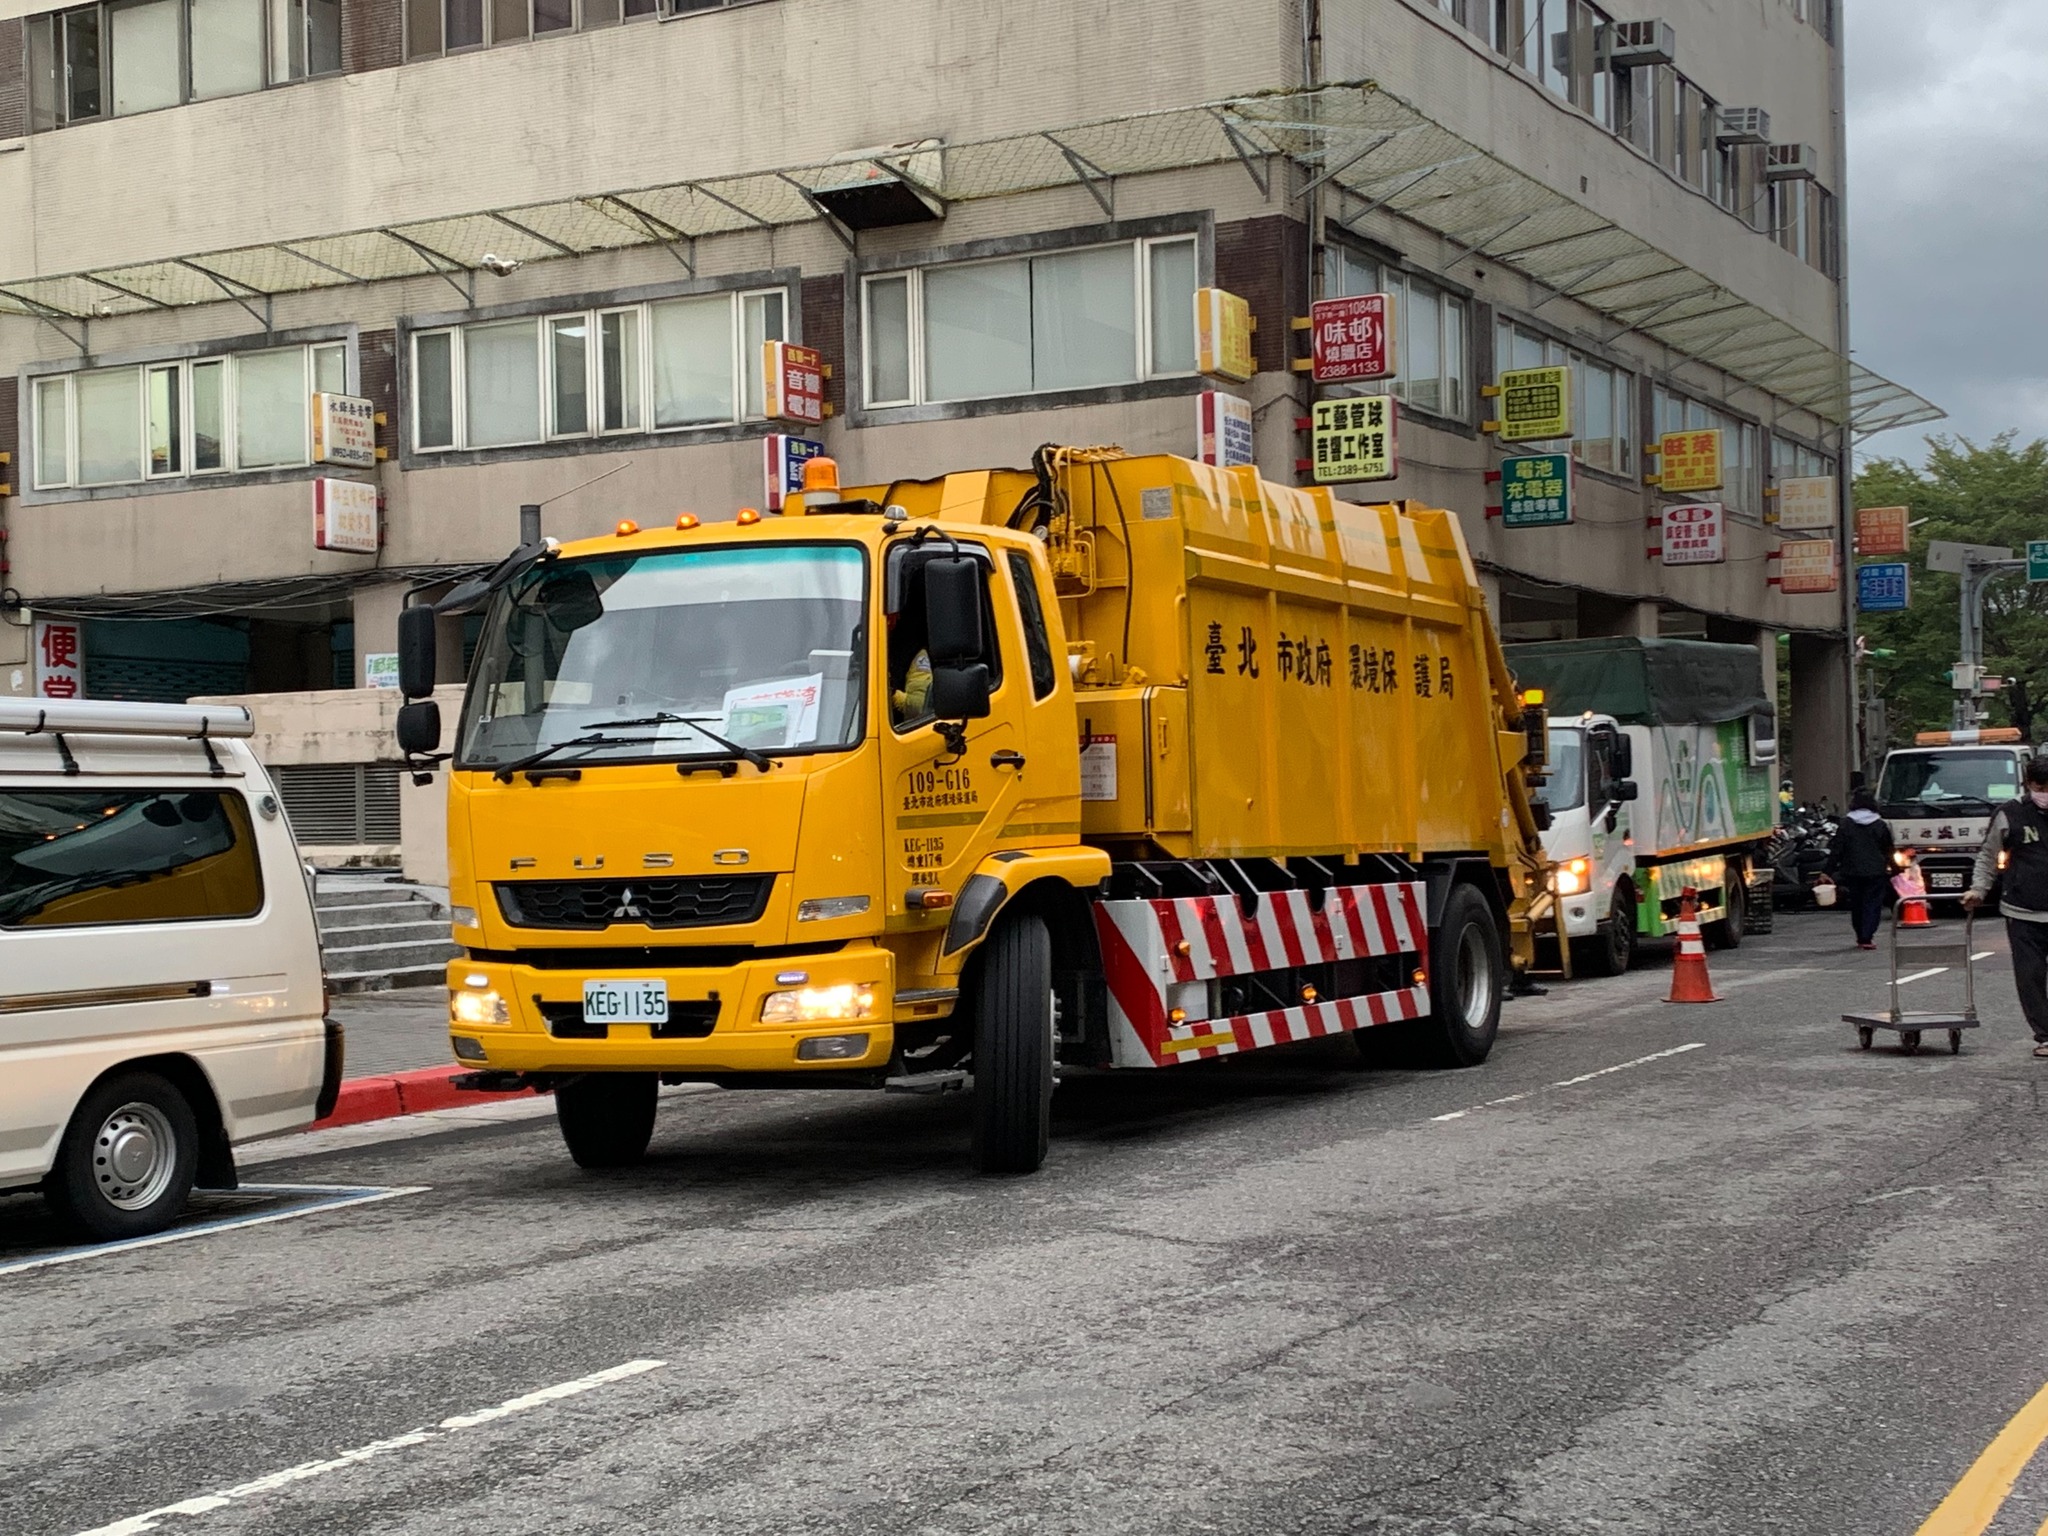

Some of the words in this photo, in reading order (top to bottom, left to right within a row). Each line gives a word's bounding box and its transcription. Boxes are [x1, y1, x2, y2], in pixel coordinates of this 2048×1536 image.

[1324, 316, 1373, 344] 味邨
[786, 369, 820, 394] 音響
[1320, 360, 1380, 378] 2388-1133
[1316, 400, 1384, 432] 工藝管球
[1316, 432, 1385, 464] 音響工作室
[1317, 462, 1385, 478] TEL:2389-6751
[1515, 459, 1554, 478] 電池
[1506, 478, 1564, 500] 充電器
[1204, 620, 1454, 700] 臺北市政府環境保護局
[908, 768, 970, 795] 109-G16
[904, 836, 944, 853] KEG-1135
[510, 848, 750, 871] FUSO
[585, 991, 666, 1016] KEG-1135
